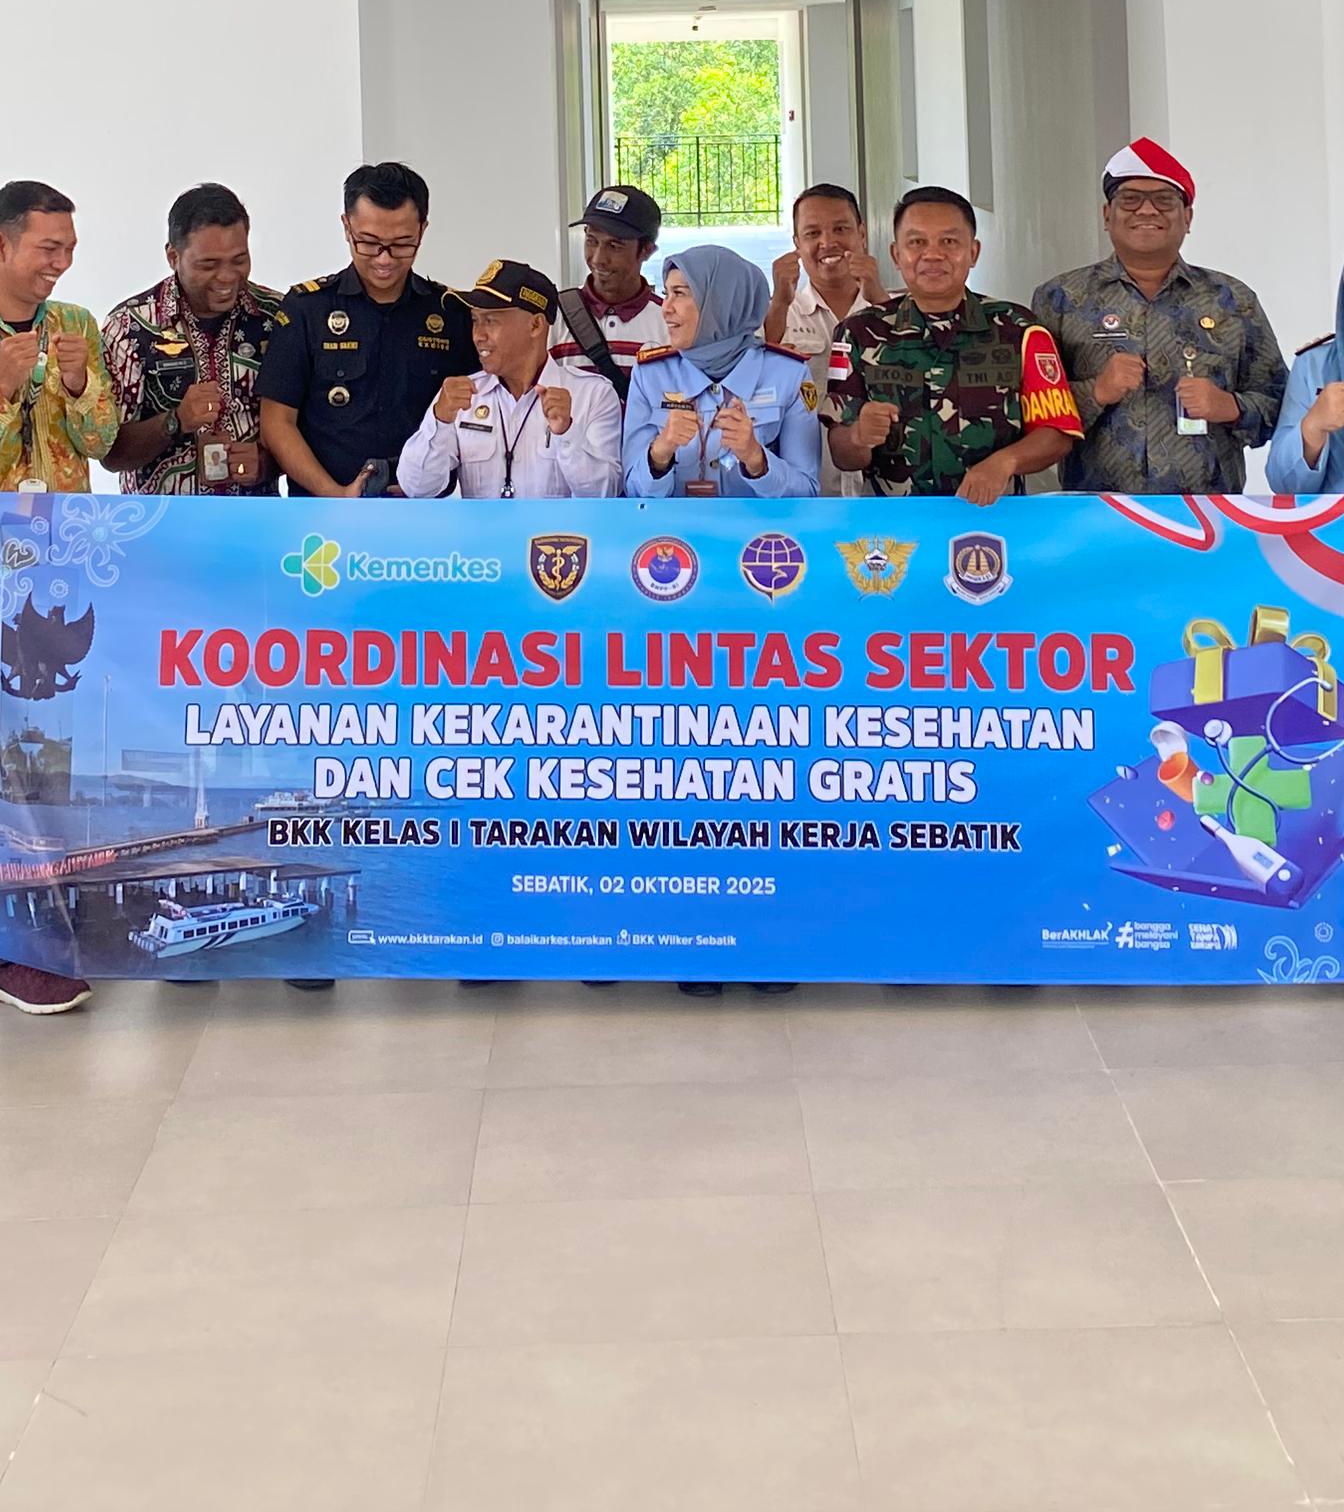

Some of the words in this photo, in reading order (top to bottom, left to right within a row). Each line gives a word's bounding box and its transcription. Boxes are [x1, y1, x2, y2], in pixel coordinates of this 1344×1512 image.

[348, 551, 502, 583] Kemenkes
[159, 628, 581, 688] KOORDINASI
[606, 631, 843, 689] LINTAS
[865, 631, 1136, 692] SEKTOR
[184, 702, 399, 746] LAYANAN
[411, 703, 811, 748] KEKARANTINAAN
[824, 705, 1096, 751] KESEHATAN
[314, 756, 412, 800] DAN
[424, 756, 516, 800] CEK
[527, 757, 796, 802] KESEHATAN
[808, 758, 978, 804] GRATIS
[268, 819, 333, 846] BKK
[342, 819, 440, 847] KELAS
[450, 819, 459, 847] I
[470, 819, 618, 848] TARAKAN
[628, 820, 770, 849] WILAYAH
[780, 821, 881, 850] KERJA
[890, 822, 1022, 851] SEBATIK
[511, 875, 594, 896] SEBATIK,
[599, 876, 625, 894] 02
[631, 876, 721, 895] OKTOBER
[726, 877, 777, 896] 2025
[1041, 928, 1109, 941] BerAKHLAK
[1134, 921, 1172, 932] bangga
[377, 934, 484, 945] www.bkktarakan.id
[507, 934, 613, 946] balaikarkes.tarakan
[632, 935, 655, 946] BKK
[658, 935, 693, 946] Wilker
[695, 935, 737, 947] Sebatik
[1134, 940, 1171, 951] bangsa
